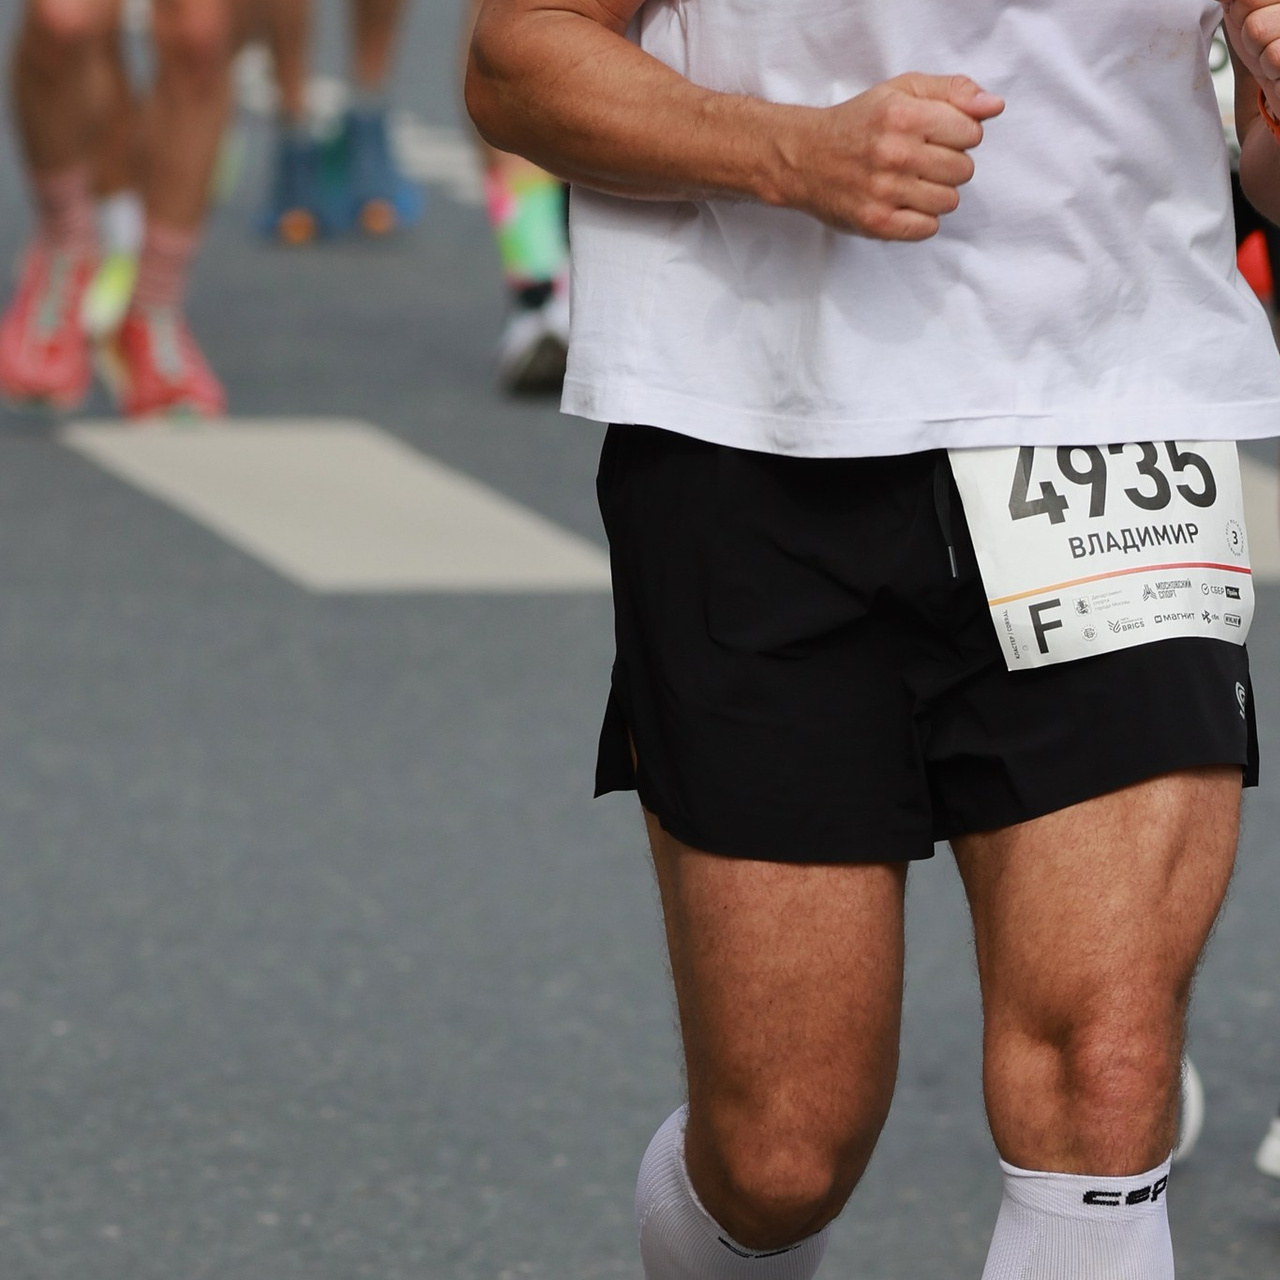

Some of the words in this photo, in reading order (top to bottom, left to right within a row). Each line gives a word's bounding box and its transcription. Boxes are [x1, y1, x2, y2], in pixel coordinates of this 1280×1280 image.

[1008, 440, 1218, 525] 4935
[1067, 523, 1199, 560] ВЛАДИМИР
[1231, 530, 1239, 546] 3
[1028, 597, 1063, 655] F
[1121, 620, 1145, 632] BRICS
